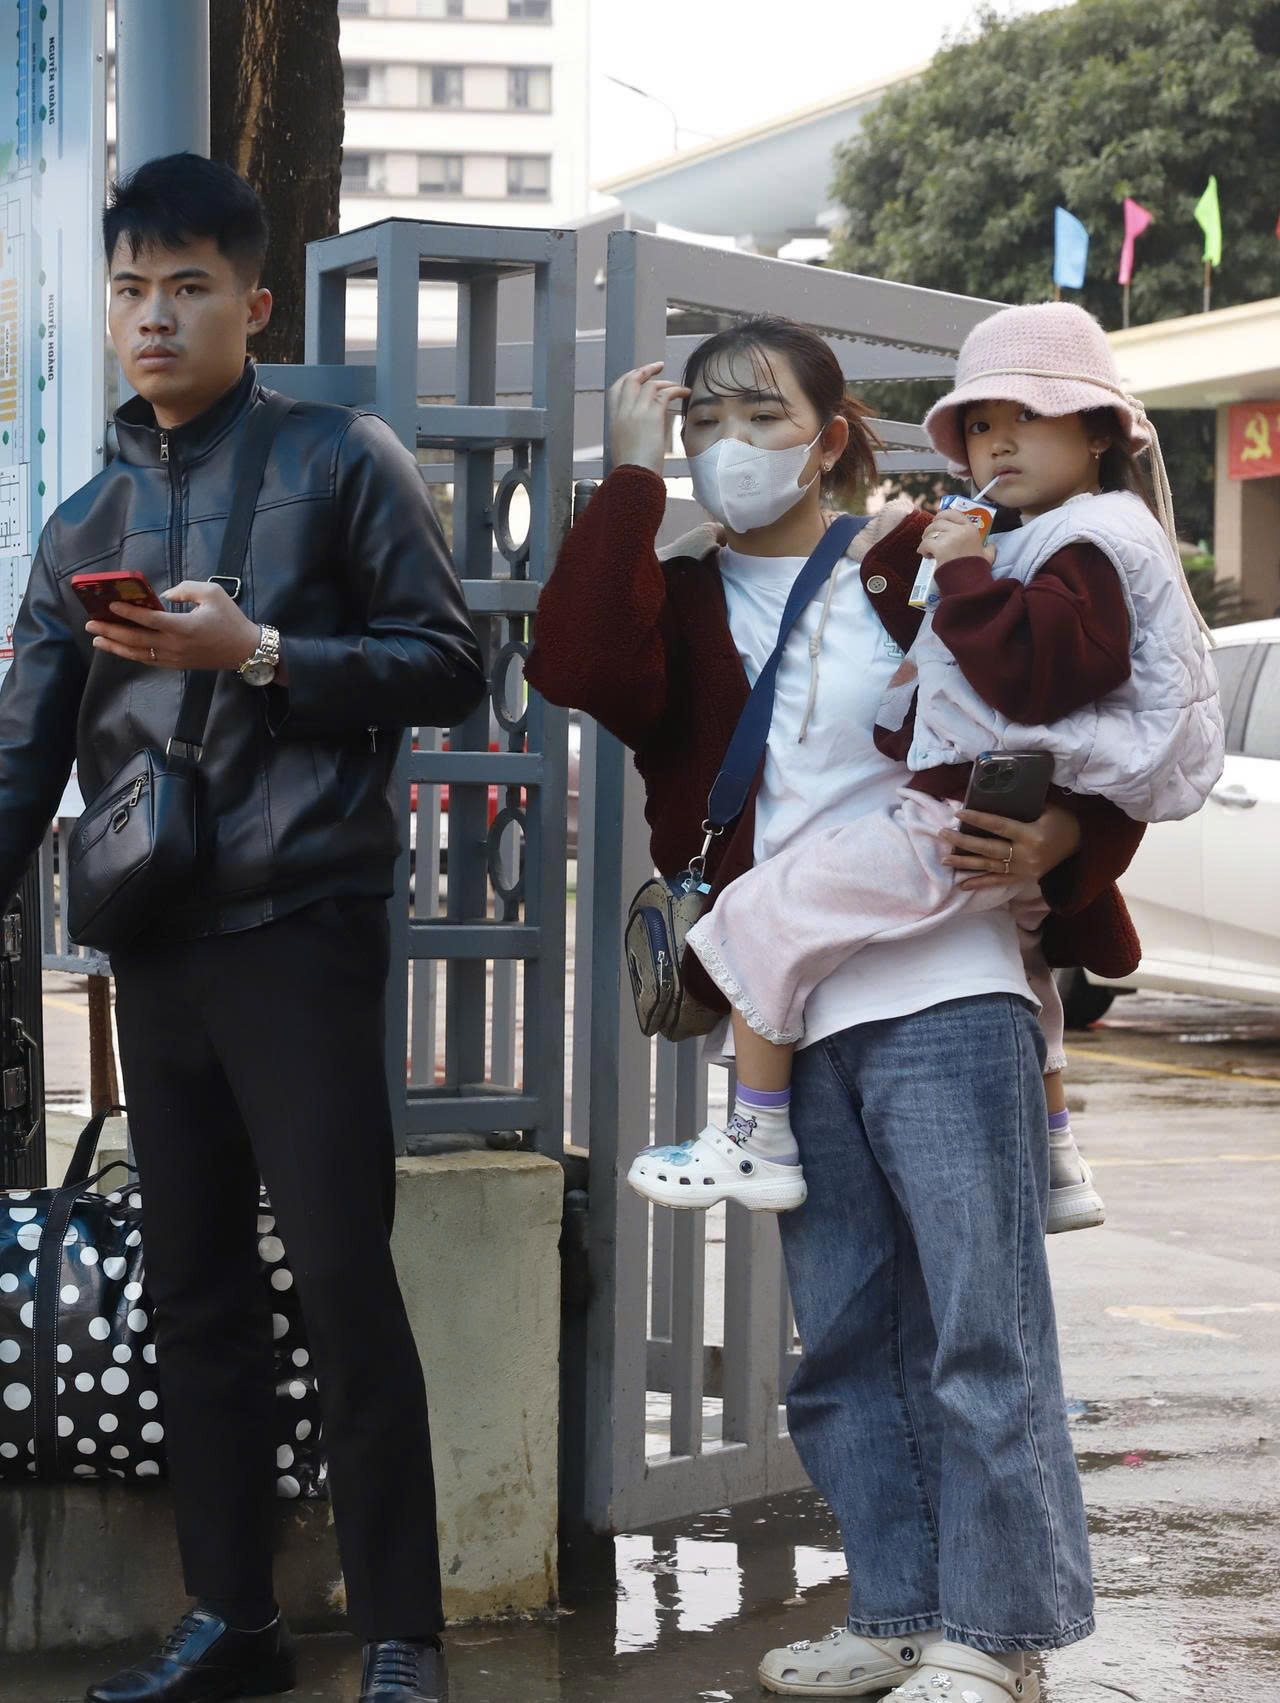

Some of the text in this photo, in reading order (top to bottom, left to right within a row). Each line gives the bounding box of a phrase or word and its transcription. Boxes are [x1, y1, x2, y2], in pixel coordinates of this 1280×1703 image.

[48, 36, 57, 125] NGUYỄN HOÀNG
[48, 341, 56, 381] HOÀNG
